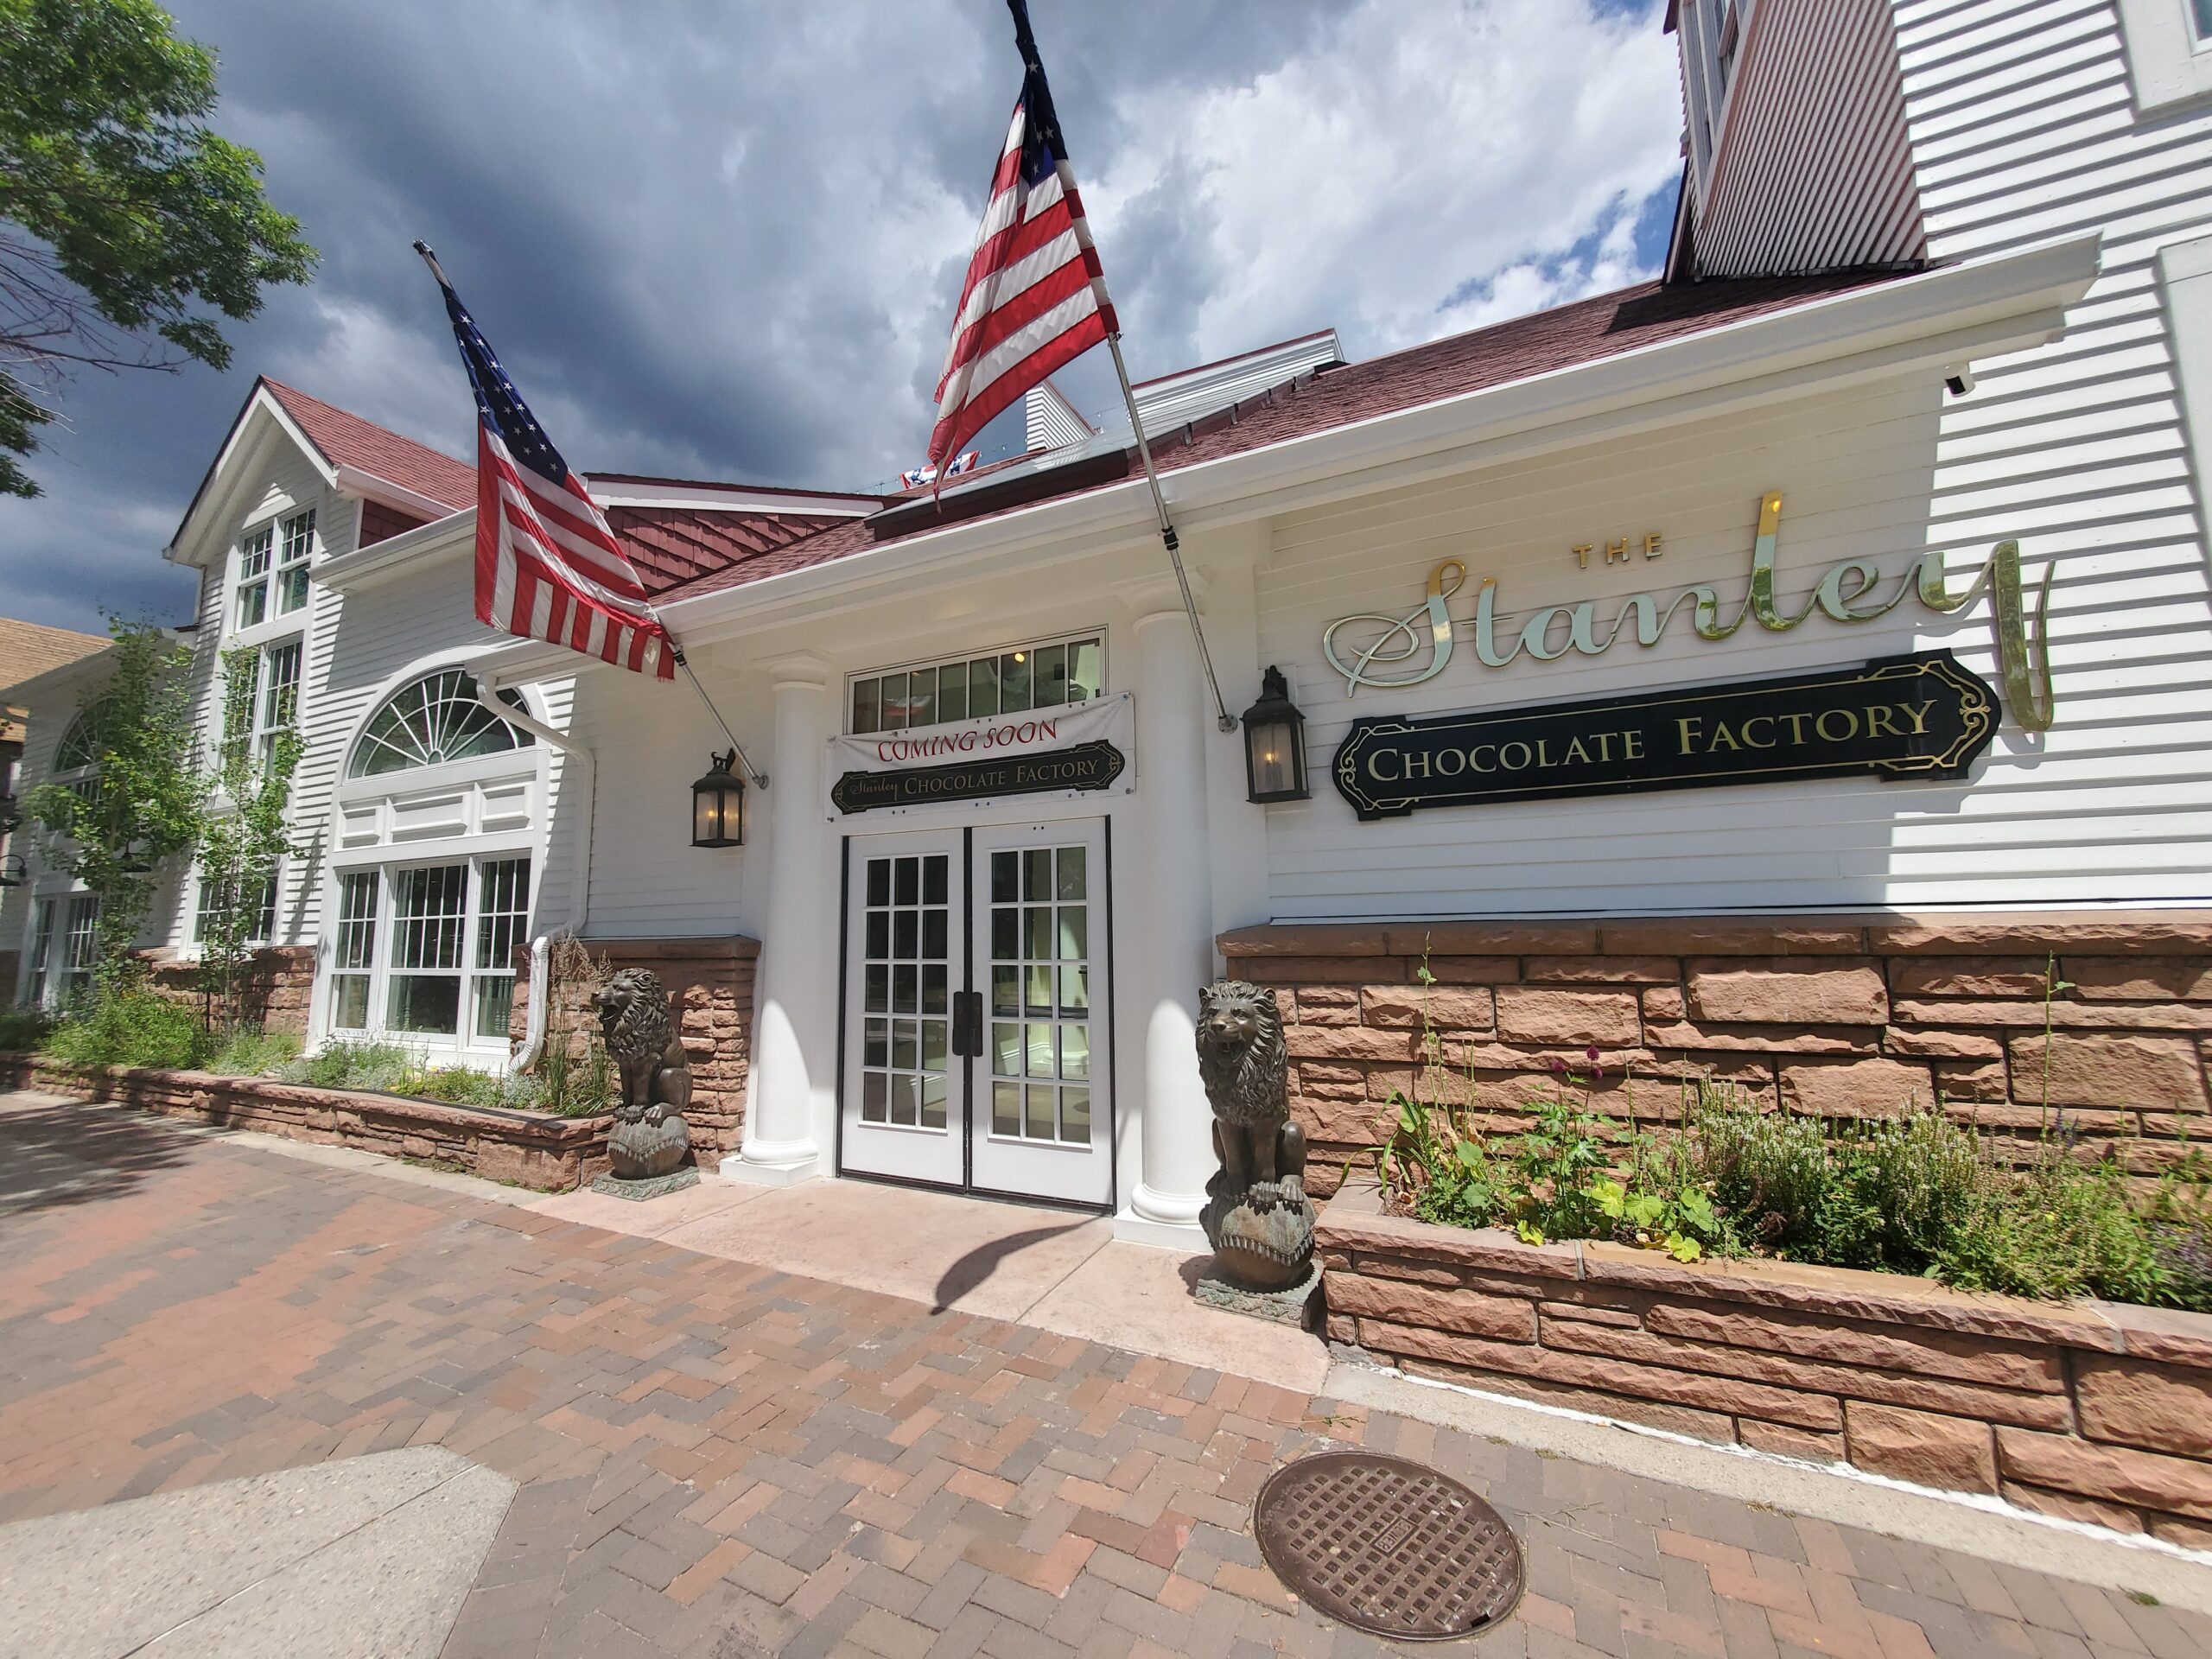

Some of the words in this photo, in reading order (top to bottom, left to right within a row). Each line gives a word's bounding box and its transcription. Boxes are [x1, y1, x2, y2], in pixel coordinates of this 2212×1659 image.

[1573, 532, 1663, 569] THE
[1323, 491, 2056, 732] Stanley
[878, 731, 977, 762] COMING
[984, 718, 1058, 748] SOON
[1368, 729, 1645, 782] CHOCOLATE
[1674, 699, 1938, 756] FACTORY
[850, 777, 898, 801] Stanley
[905, 771, 1006, 795] CHOCOLATE
[1015, 759, 1099, 783] FACTORY
